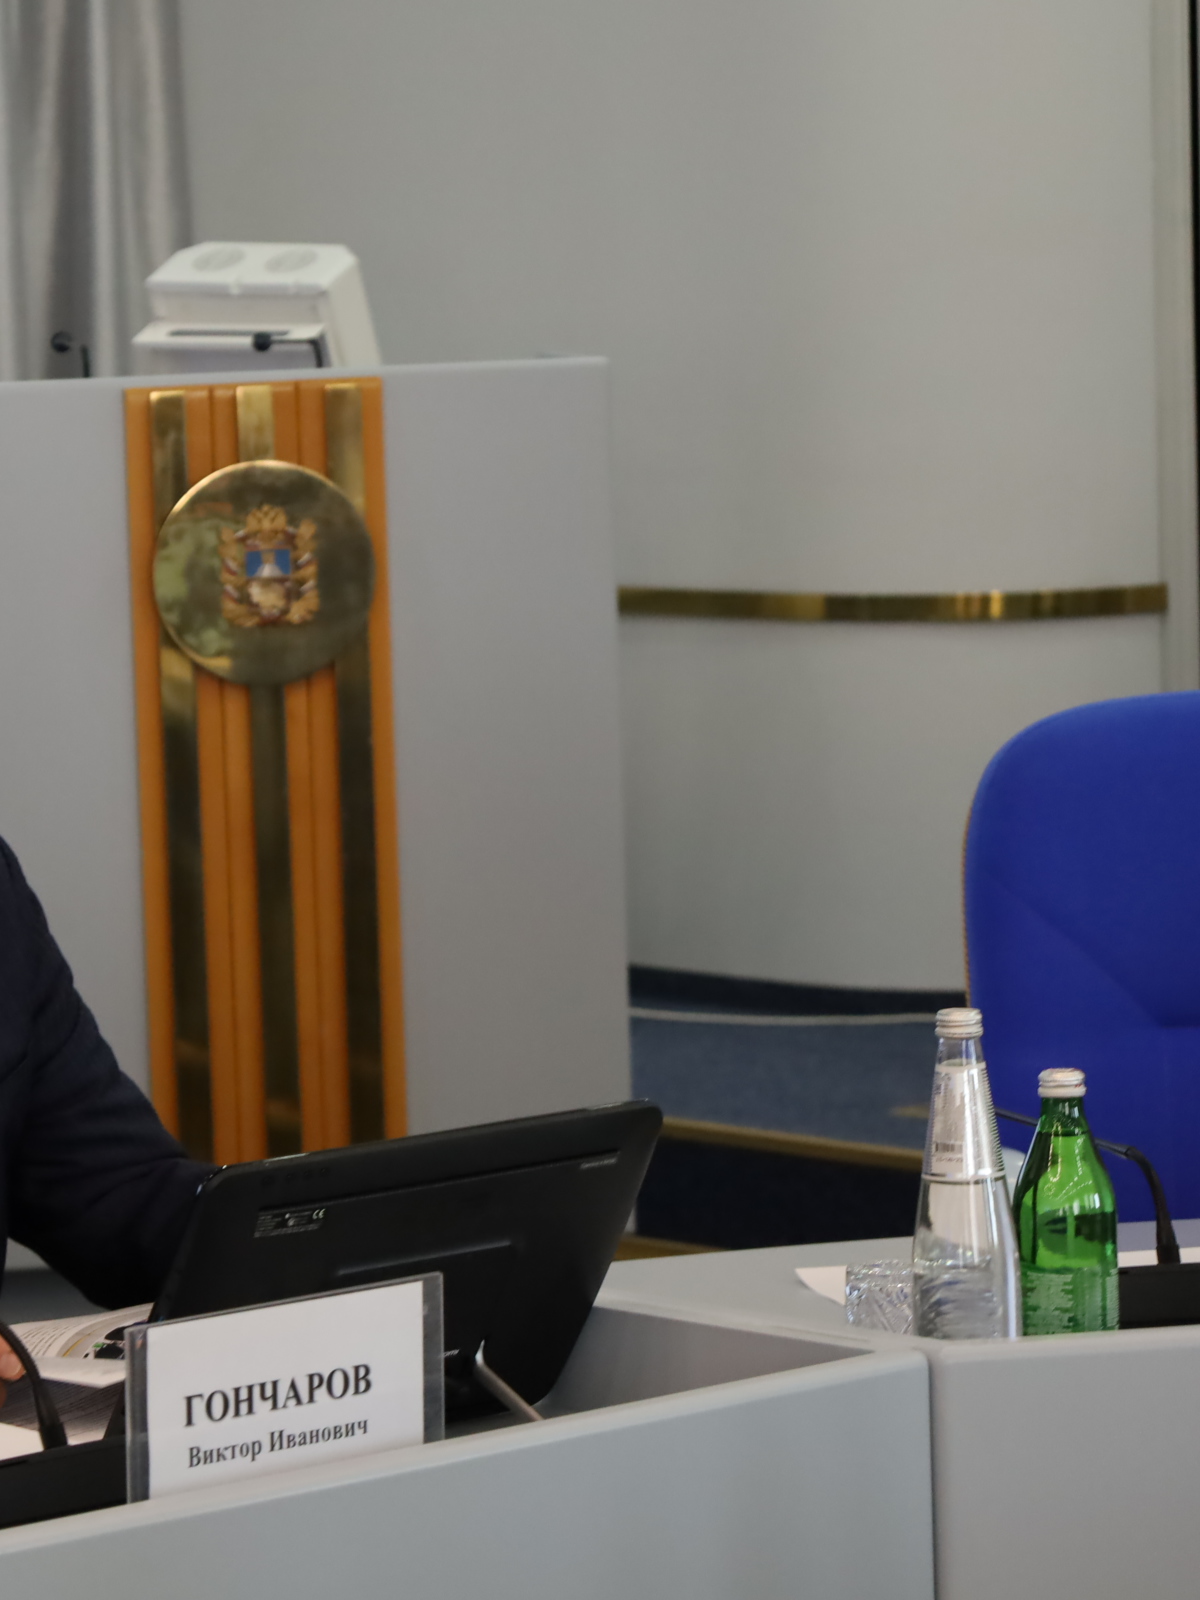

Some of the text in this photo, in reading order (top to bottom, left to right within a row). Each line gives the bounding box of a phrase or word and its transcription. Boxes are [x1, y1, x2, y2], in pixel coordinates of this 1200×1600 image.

[184, 1364, 373, 1427] ГОНЧАРОВ
[188, 1419, 368, 1468] Виктор Иванович
